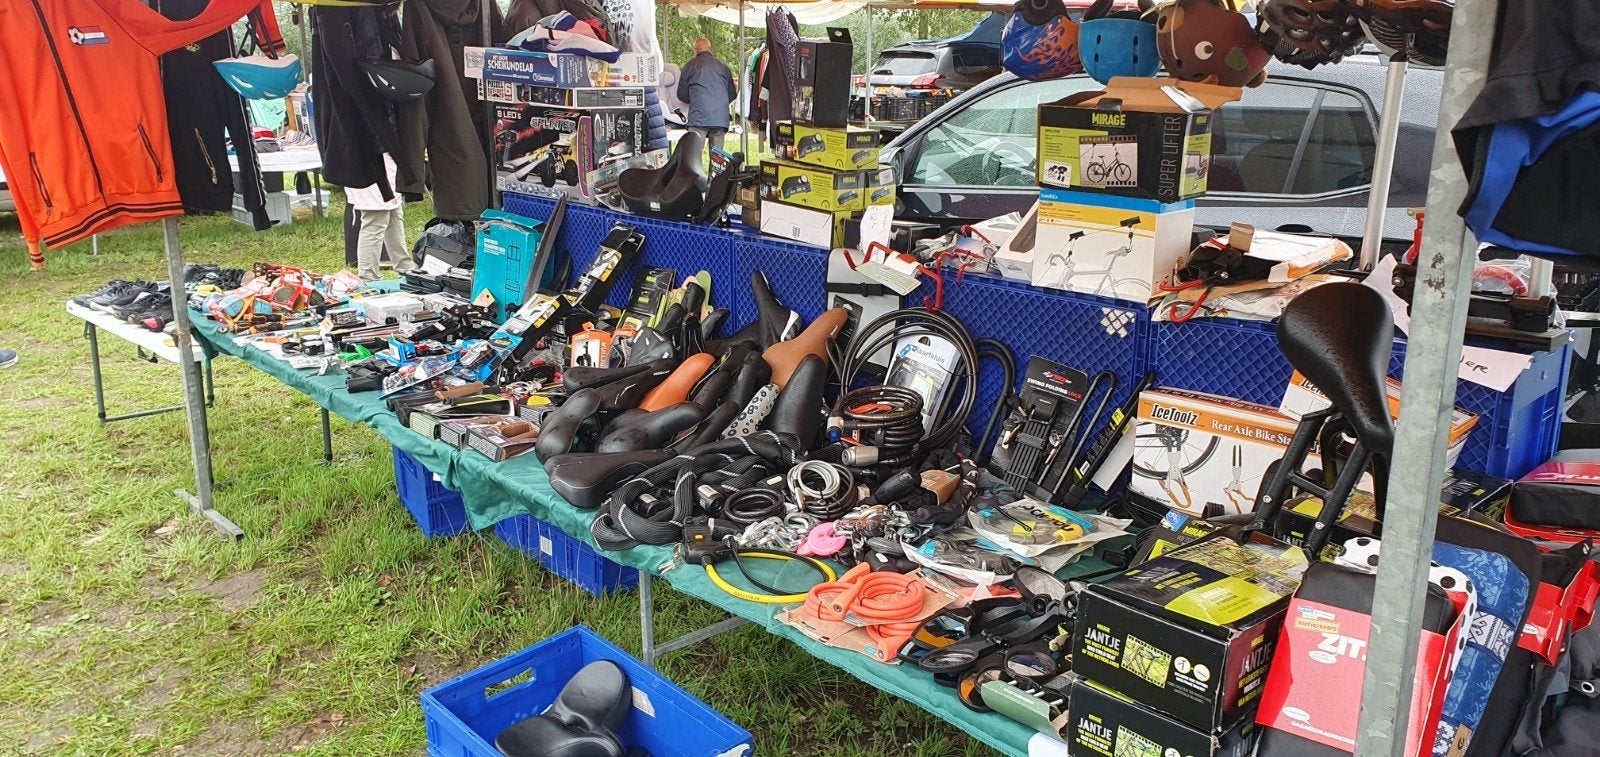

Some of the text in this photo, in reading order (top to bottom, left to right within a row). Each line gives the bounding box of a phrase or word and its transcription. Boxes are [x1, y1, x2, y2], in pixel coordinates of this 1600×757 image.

[487, 60, 534, 73] SCHEIKUNDELAB
[497, 110, 503, 118] 8
[1091, 112, 1126, 126] MIRAGE
[1158, 116, 1183, 196] SUPER LIFTER
[1027, 378, 1082, 400] SWING FOLDING LOCK
[1151, 403, 1198, 426] IceToolz
[1211, 418, 1292, 444] Rear Axle Bike Sta
[1084, 627, 1121, 651] JANTJE
[1238, 642, 1272, 678] JANTJE
[1077, 717, 1113, 741] JANTJE
